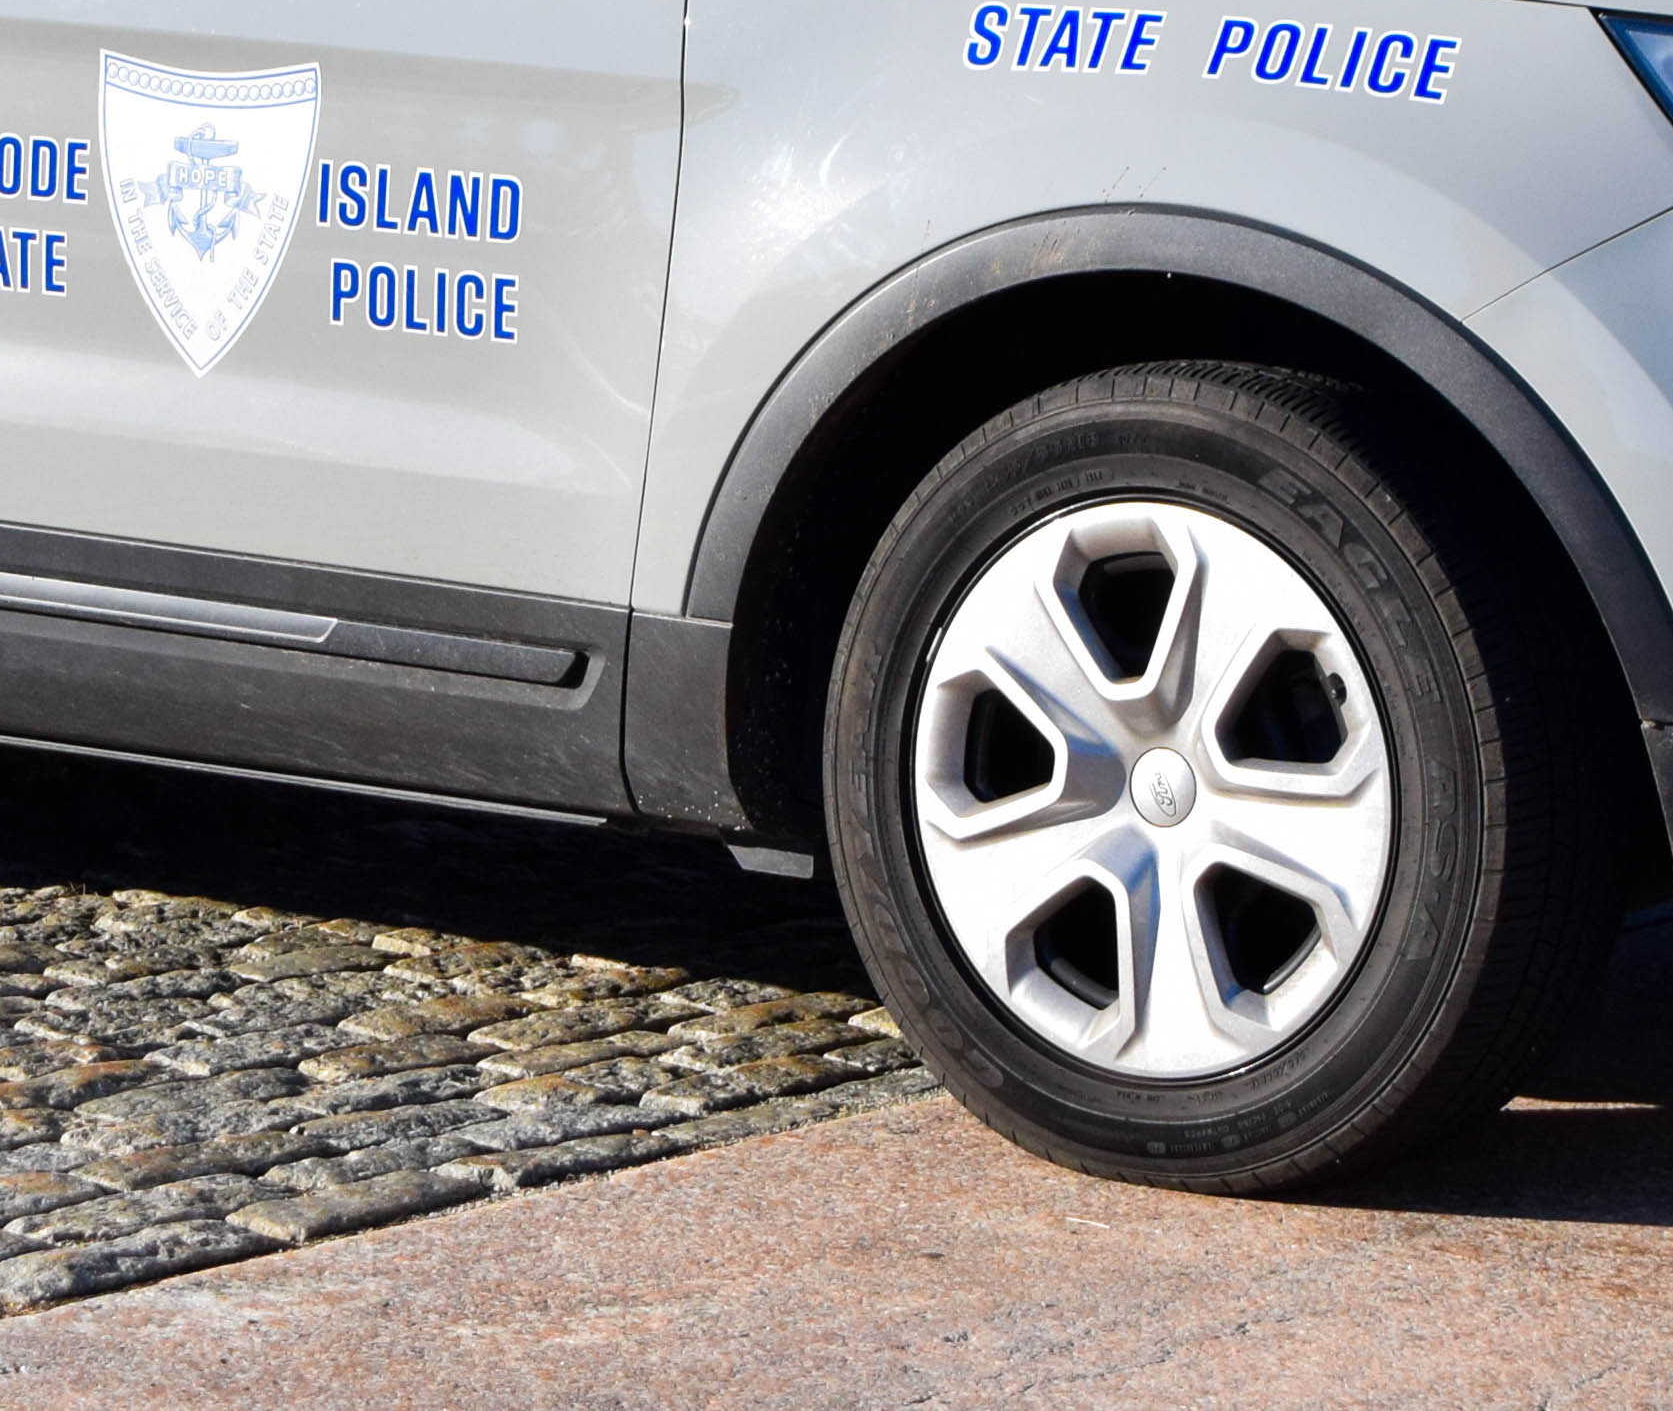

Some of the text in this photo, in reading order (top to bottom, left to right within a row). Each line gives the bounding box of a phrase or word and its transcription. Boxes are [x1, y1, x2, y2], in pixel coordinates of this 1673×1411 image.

[962, 1, 1463, 105] STATE POLICE
[178, 165, 228, 188] HOPE
[316, 158, 524, 245] ISLAND
[119, 178, 198, 341] IN THE SERVICE
[206, 194, 290, 342] OF THE STATE
[329, 258, 520, 345] POLICE
[1257, 466, 1445, 703] EAGLE
